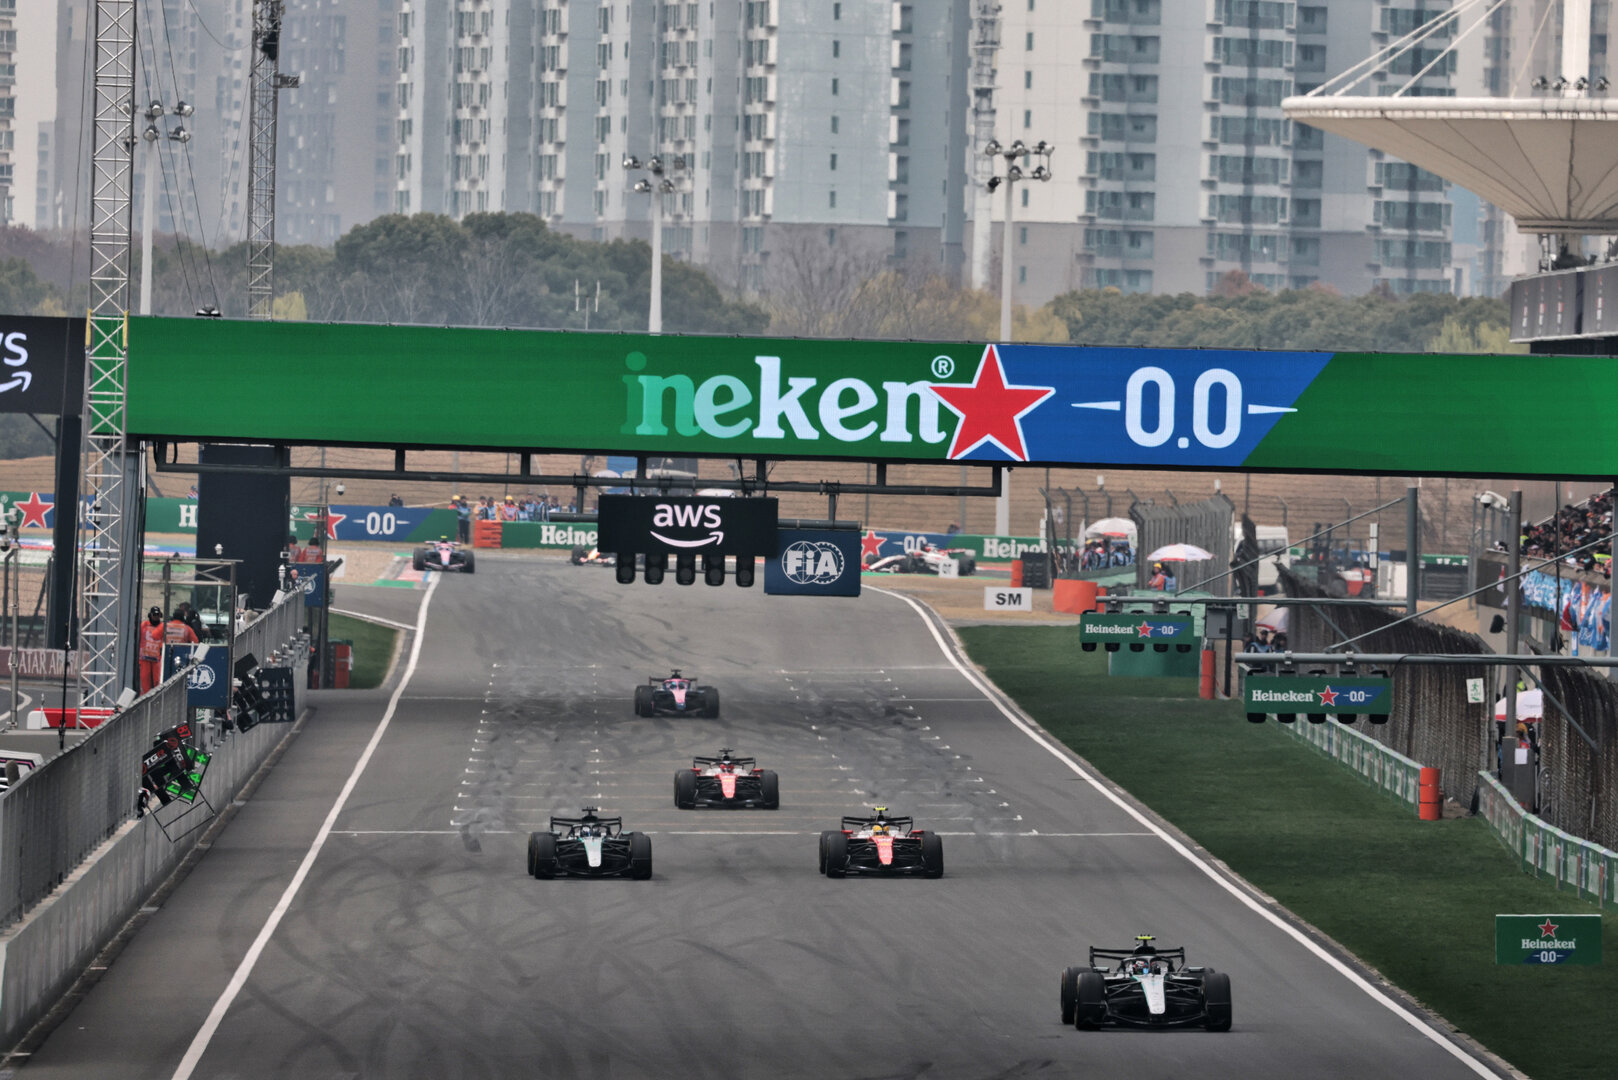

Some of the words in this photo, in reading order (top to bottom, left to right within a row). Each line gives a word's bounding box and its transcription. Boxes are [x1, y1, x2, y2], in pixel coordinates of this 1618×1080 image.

[995, 592, 1022, 606] SM
[1085, 624, 1134, 634] Heineken
[1252, 689, 1314, 702] Heineken
[1521, 938, 1576, 949] Heineken
